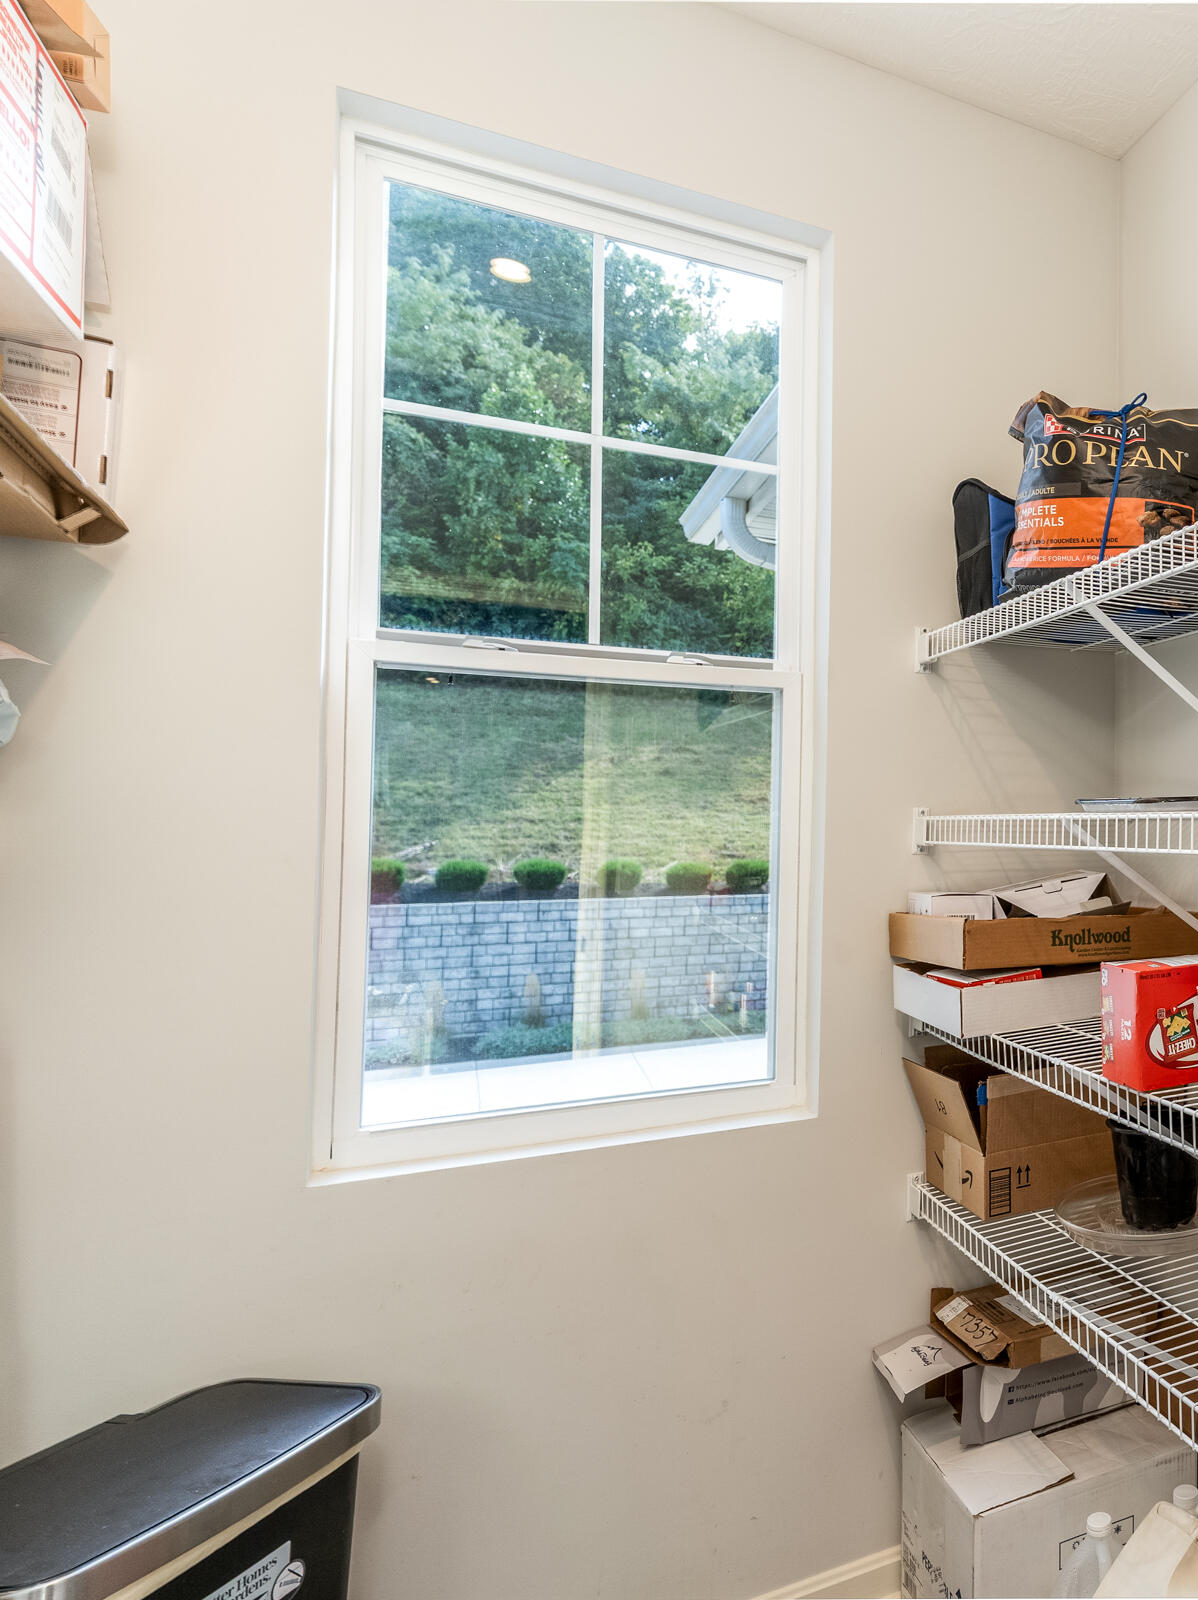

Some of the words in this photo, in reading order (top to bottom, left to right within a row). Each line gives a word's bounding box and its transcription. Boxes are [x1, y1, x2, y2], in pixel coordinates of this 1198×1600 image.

[1032, 487, 1056, 496] ADULTE
[1048, 554, 1080, 562] FORMULA
[1051, 926, 1131, 952] Knollwood
[960, 1312, 999, 1348] 7357
[236, 1559, 278, 1591] Homes
